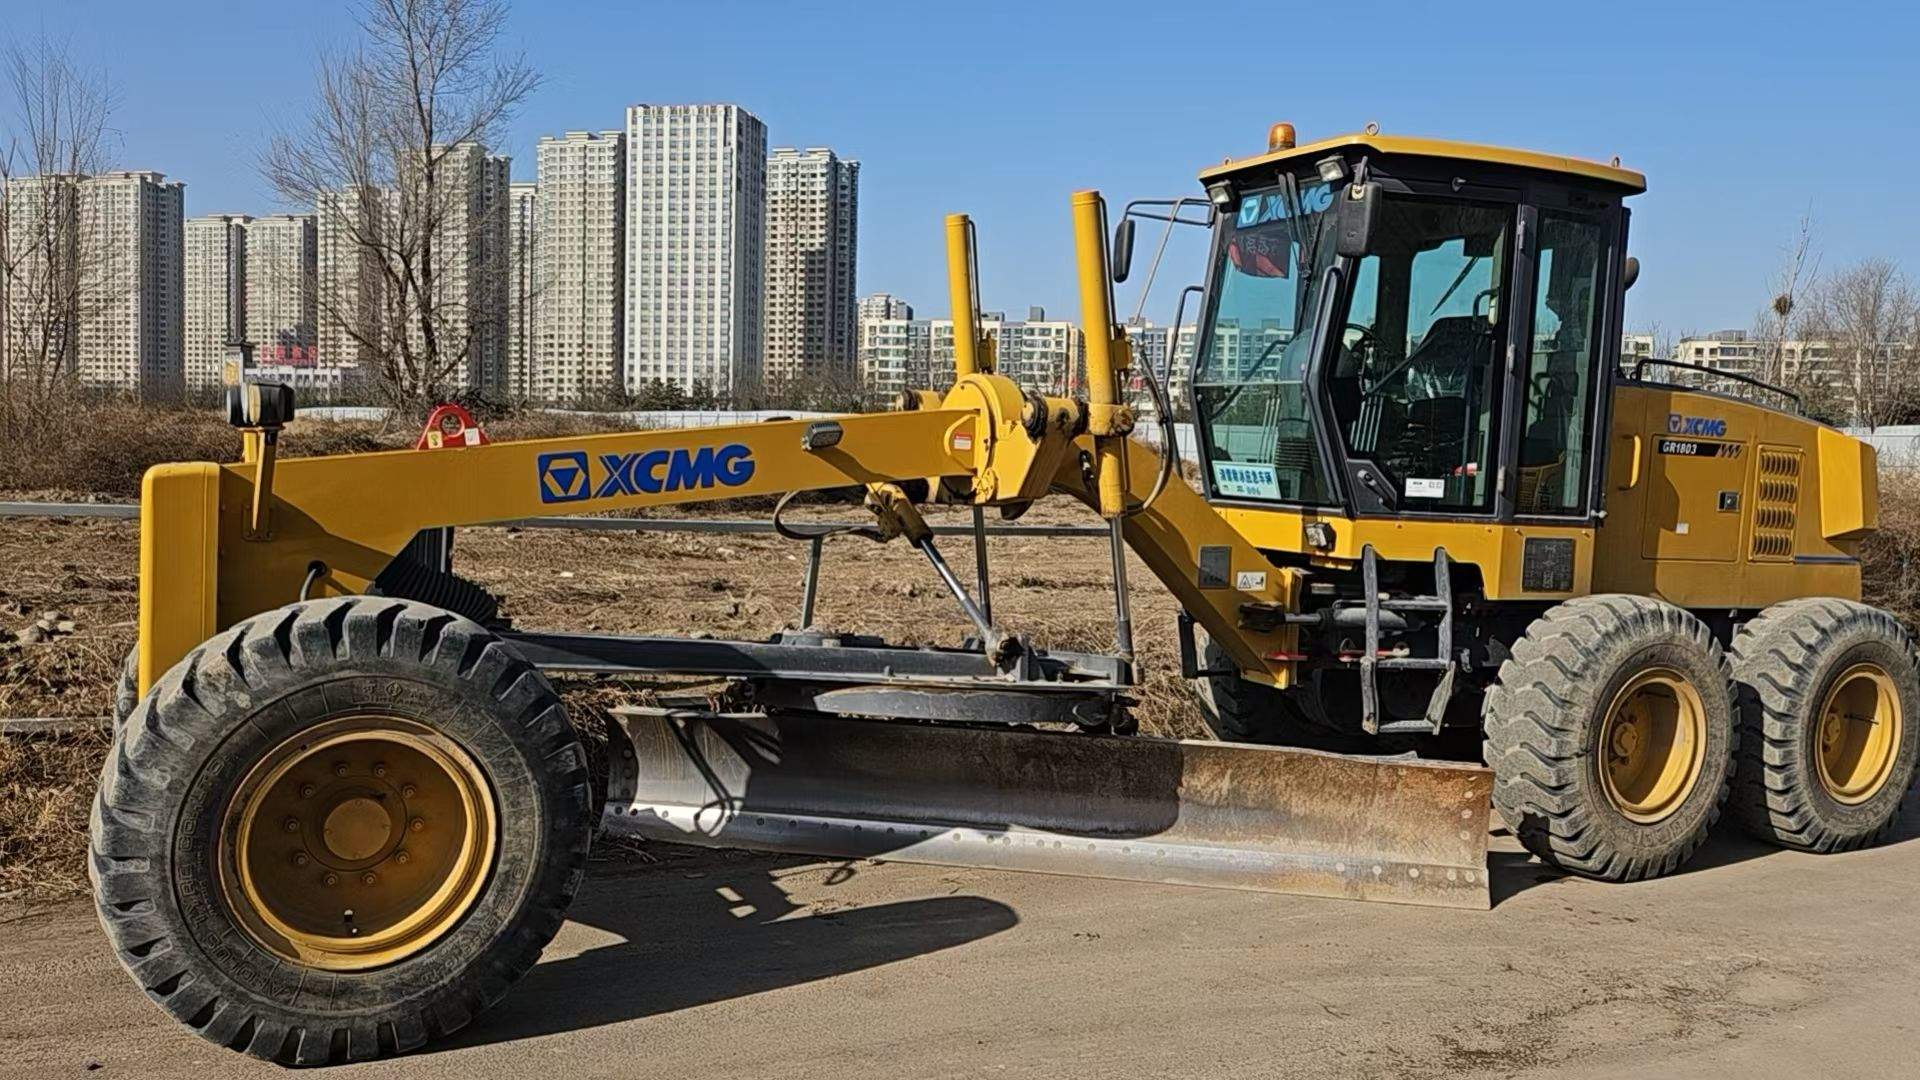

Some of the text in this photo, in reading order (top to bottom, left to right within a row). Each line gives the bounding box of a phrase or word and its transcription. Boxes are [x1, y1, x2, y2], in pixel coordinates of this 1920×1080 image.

[1681, 417, 1727, 437] XCMG
[1662, 441, 1698, 455] GR1803
[592, 444, 756, 499] XCMG
